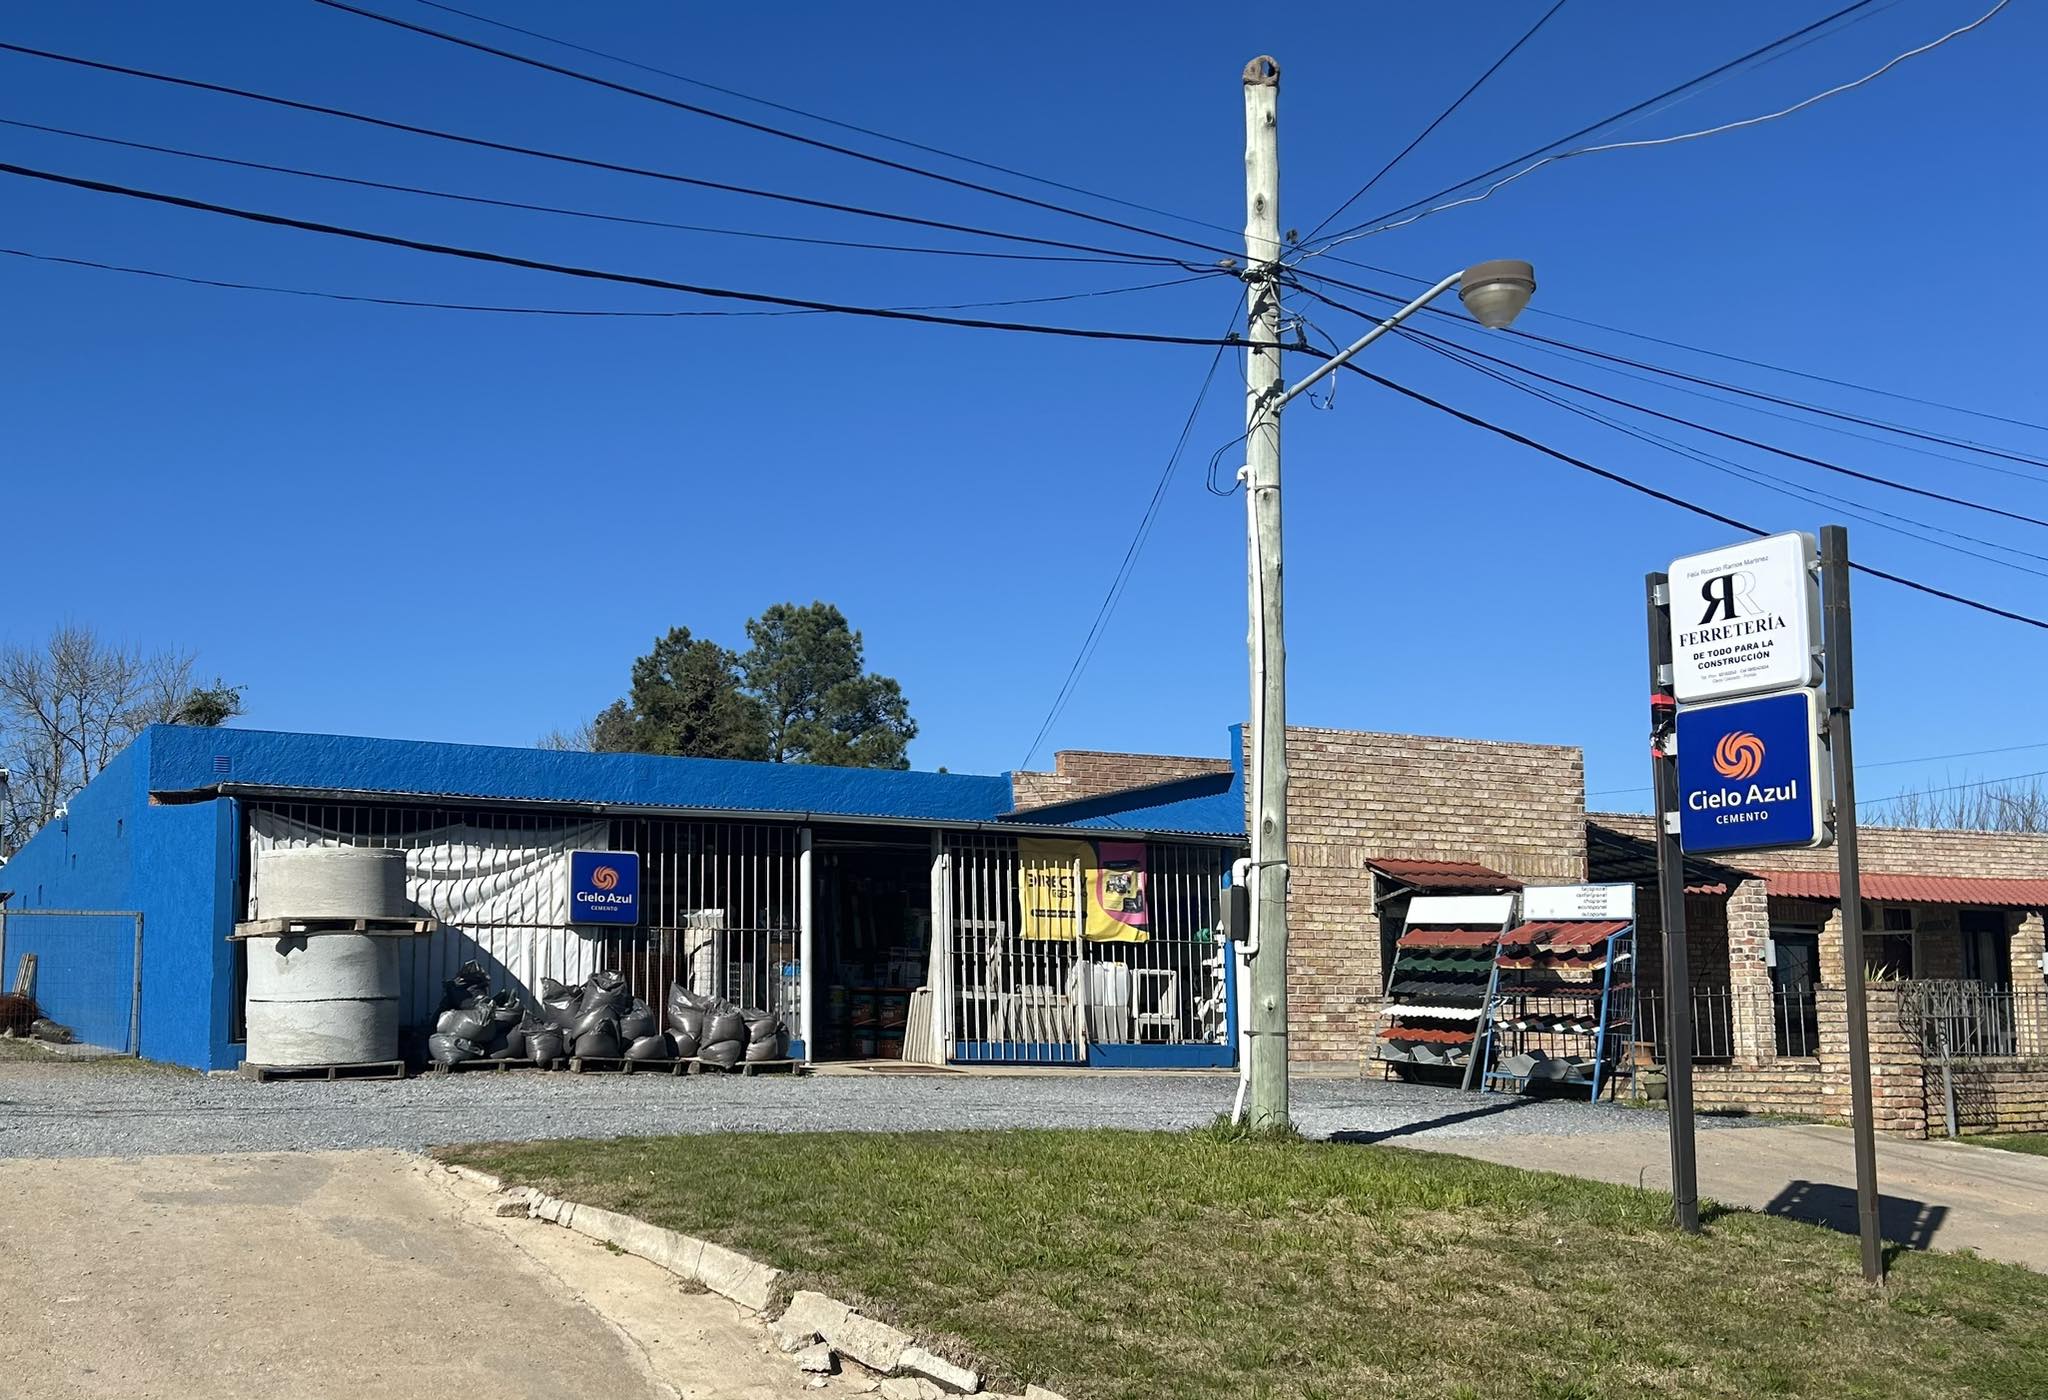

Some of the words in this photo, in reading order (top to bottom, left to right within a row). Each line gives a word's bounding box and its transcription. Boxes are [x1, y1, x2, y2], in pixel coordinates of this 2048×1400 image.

[1679, 613, 1786, 647] FERRETERÍA
[1693, 651, 1705, 660] DE
[1708, 647, 1732, 658] TODO
[1735, 643, 1759, 654] PARA
[1762, 639, 1774, 648] LA
[1698, 651, 1770, 670] CONSTRUCCIÓN
[1688, 788, 1742, 811] Cielo
[1746, 780, 1797, 805] Azul
[1716, 810, 1769, 825] CEMENTO
[576, 891, 606, 903] Cielo
[607, 893, 632, 904] Azul
